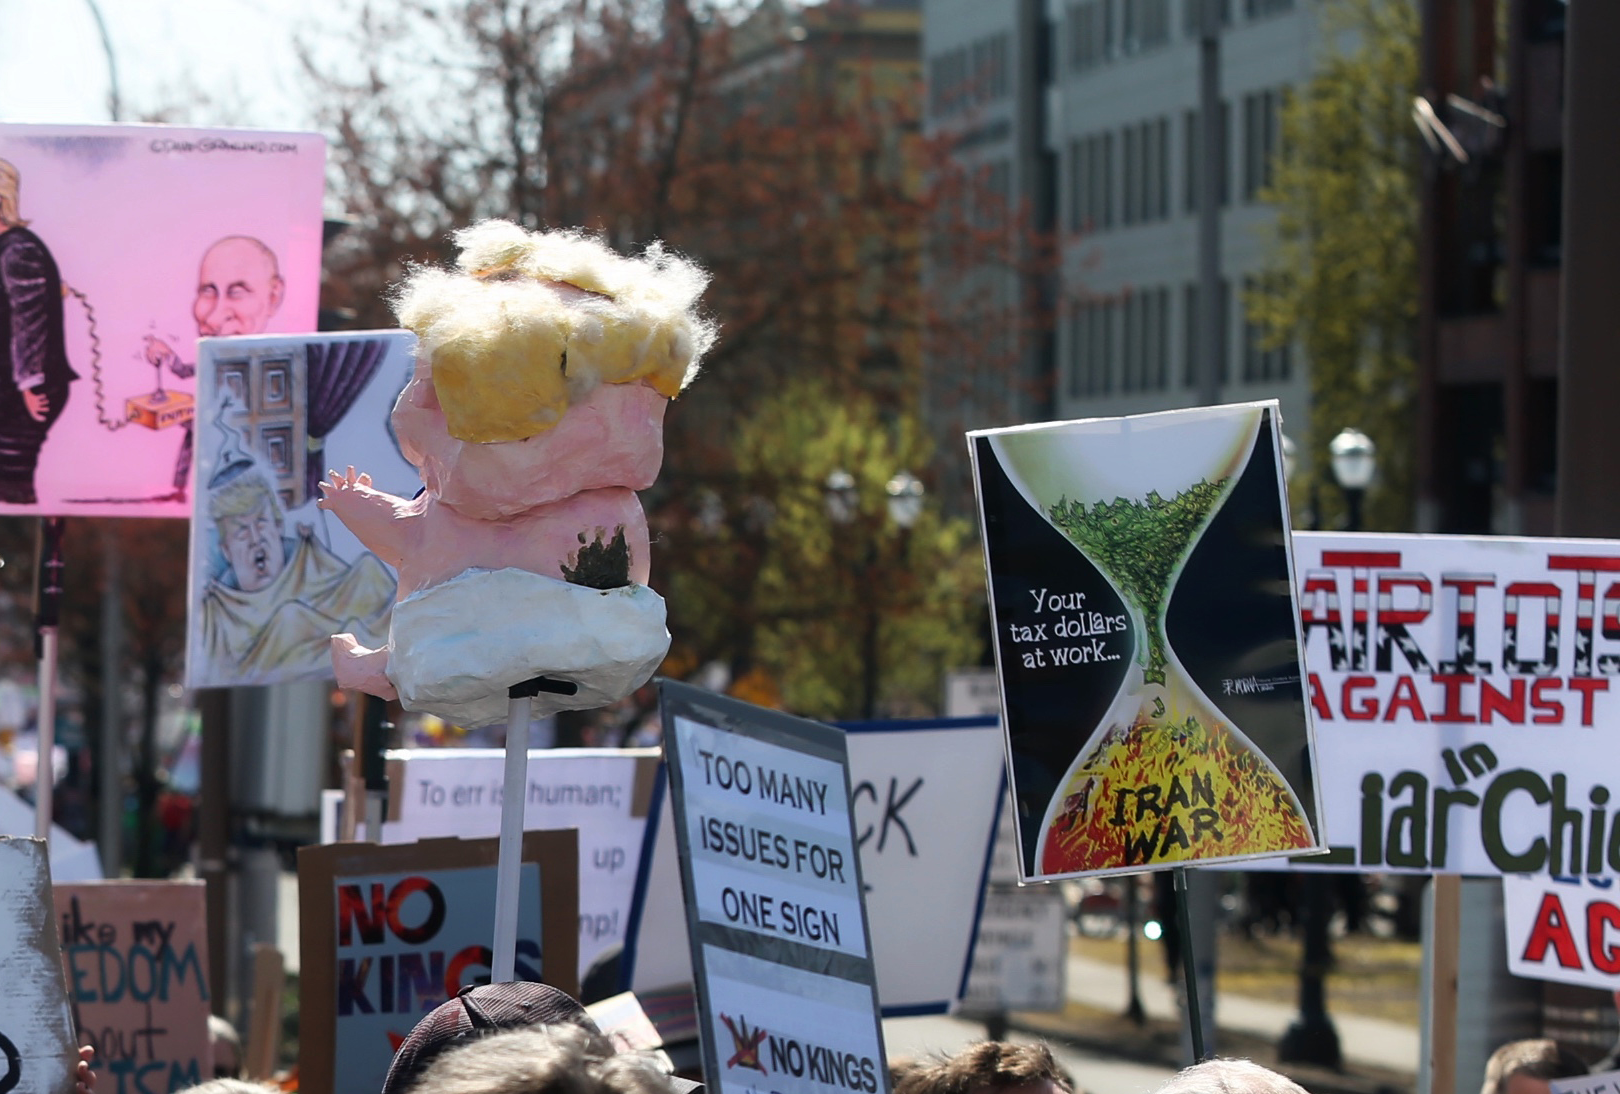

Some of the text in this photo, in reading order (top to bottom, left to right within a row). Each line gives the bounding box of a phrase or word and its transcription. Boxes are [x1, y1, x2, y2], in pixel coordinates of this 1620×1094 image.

[1029, 588, 1086, 613] Your
[1302, 551, 1620, 678] ATRIOT
[1009, 623, 1049, 643] tax
[1022, 638, 1121, 668] at work...
[1309, 672, 1609, 728] AGAINST
[698, 750, 829, 817] TOO MANY
[1441, 742, 1499, 787] in
[418, 780, 622, 809] To err is human;
[852, 776, 925, 858] CK
[1108, 770, 1216, 827] IRAN
[593, 847, 626, 874] up
[699, 815, 847, 884] ISSUES FOR
[1124, 808, 1224, 866] WAR
[62, 895, 117, 946] ike
[337, 876, 446, 946] NO
[721, 886, 842, 947] ONE SIGN
[1521, 891, 1620, 976] AG
[60, 941, 211, 1004] EDOM
[768, 1034, 878, 1094] NO KINGS
